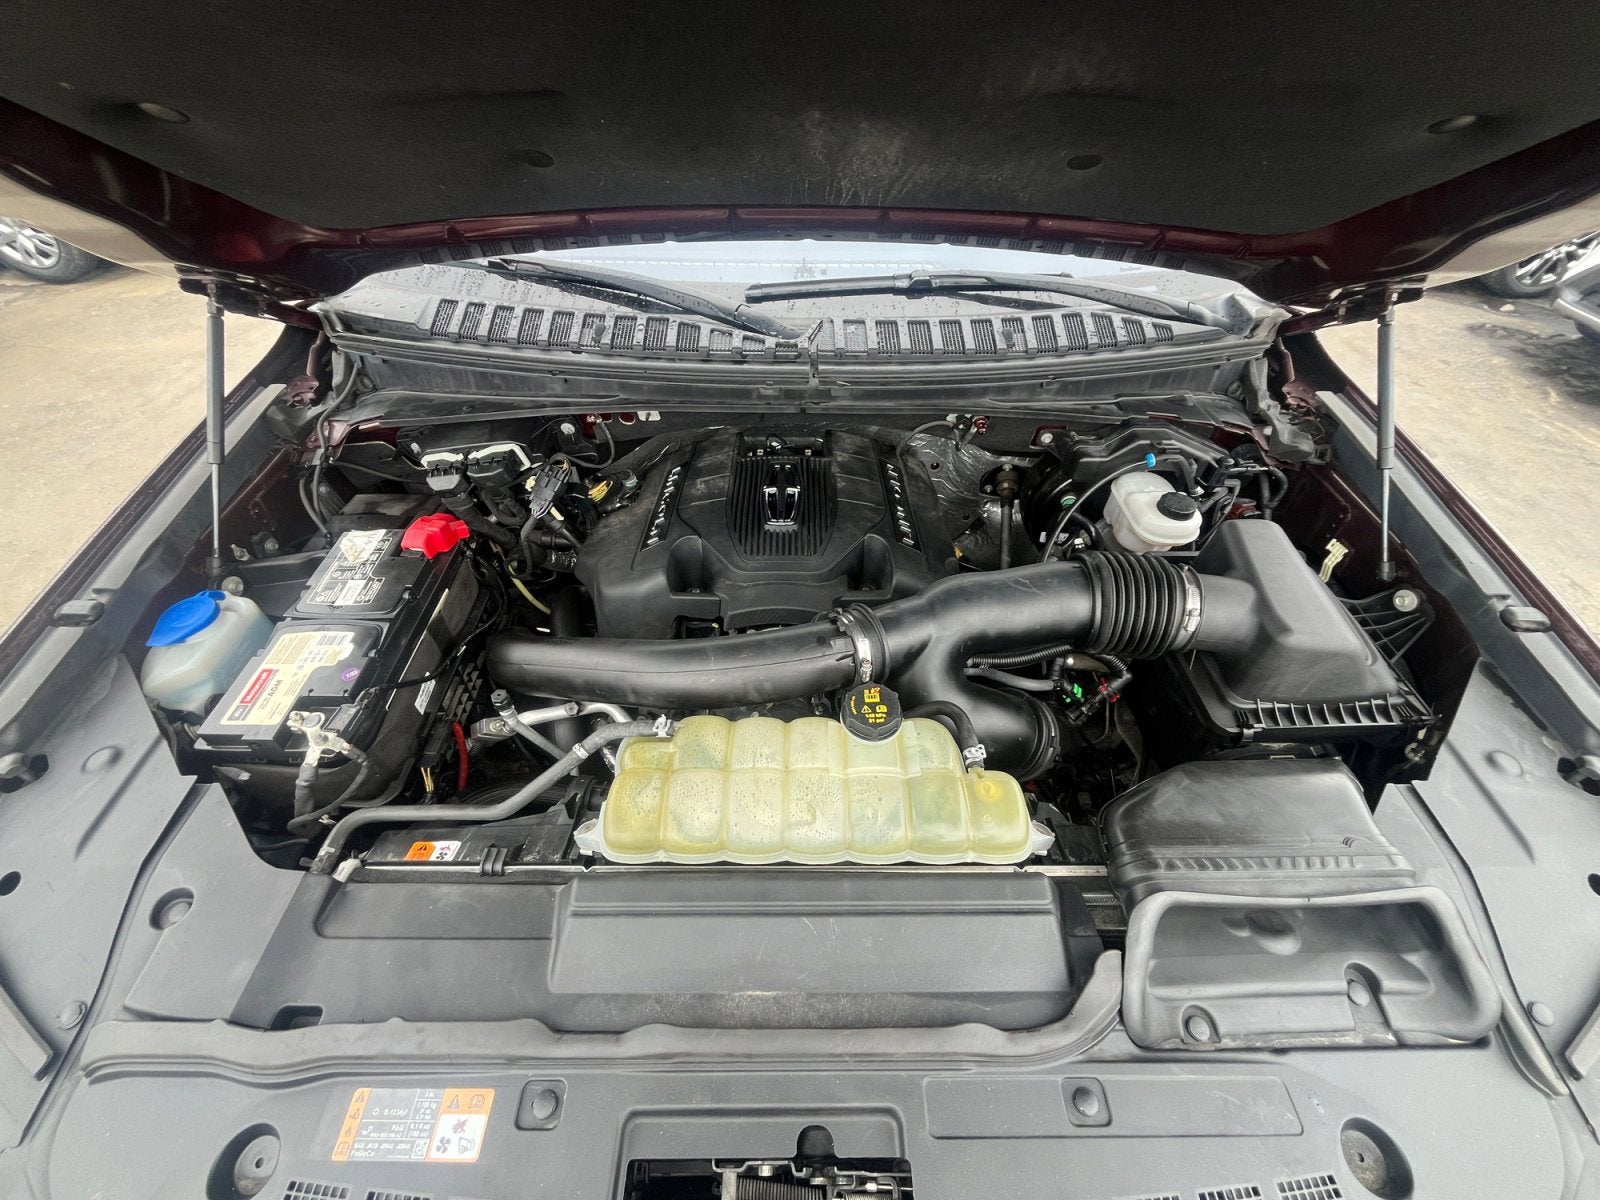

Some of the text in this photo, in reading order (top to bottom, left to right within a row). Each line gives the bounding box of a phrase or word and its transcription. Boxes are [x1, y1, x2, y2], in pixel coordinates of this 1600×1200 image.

[646, 466, 682, 547] LINCOLN
[243, 671, 271, 703] Motorcraft
[268, 679, 284, 697] AGM
